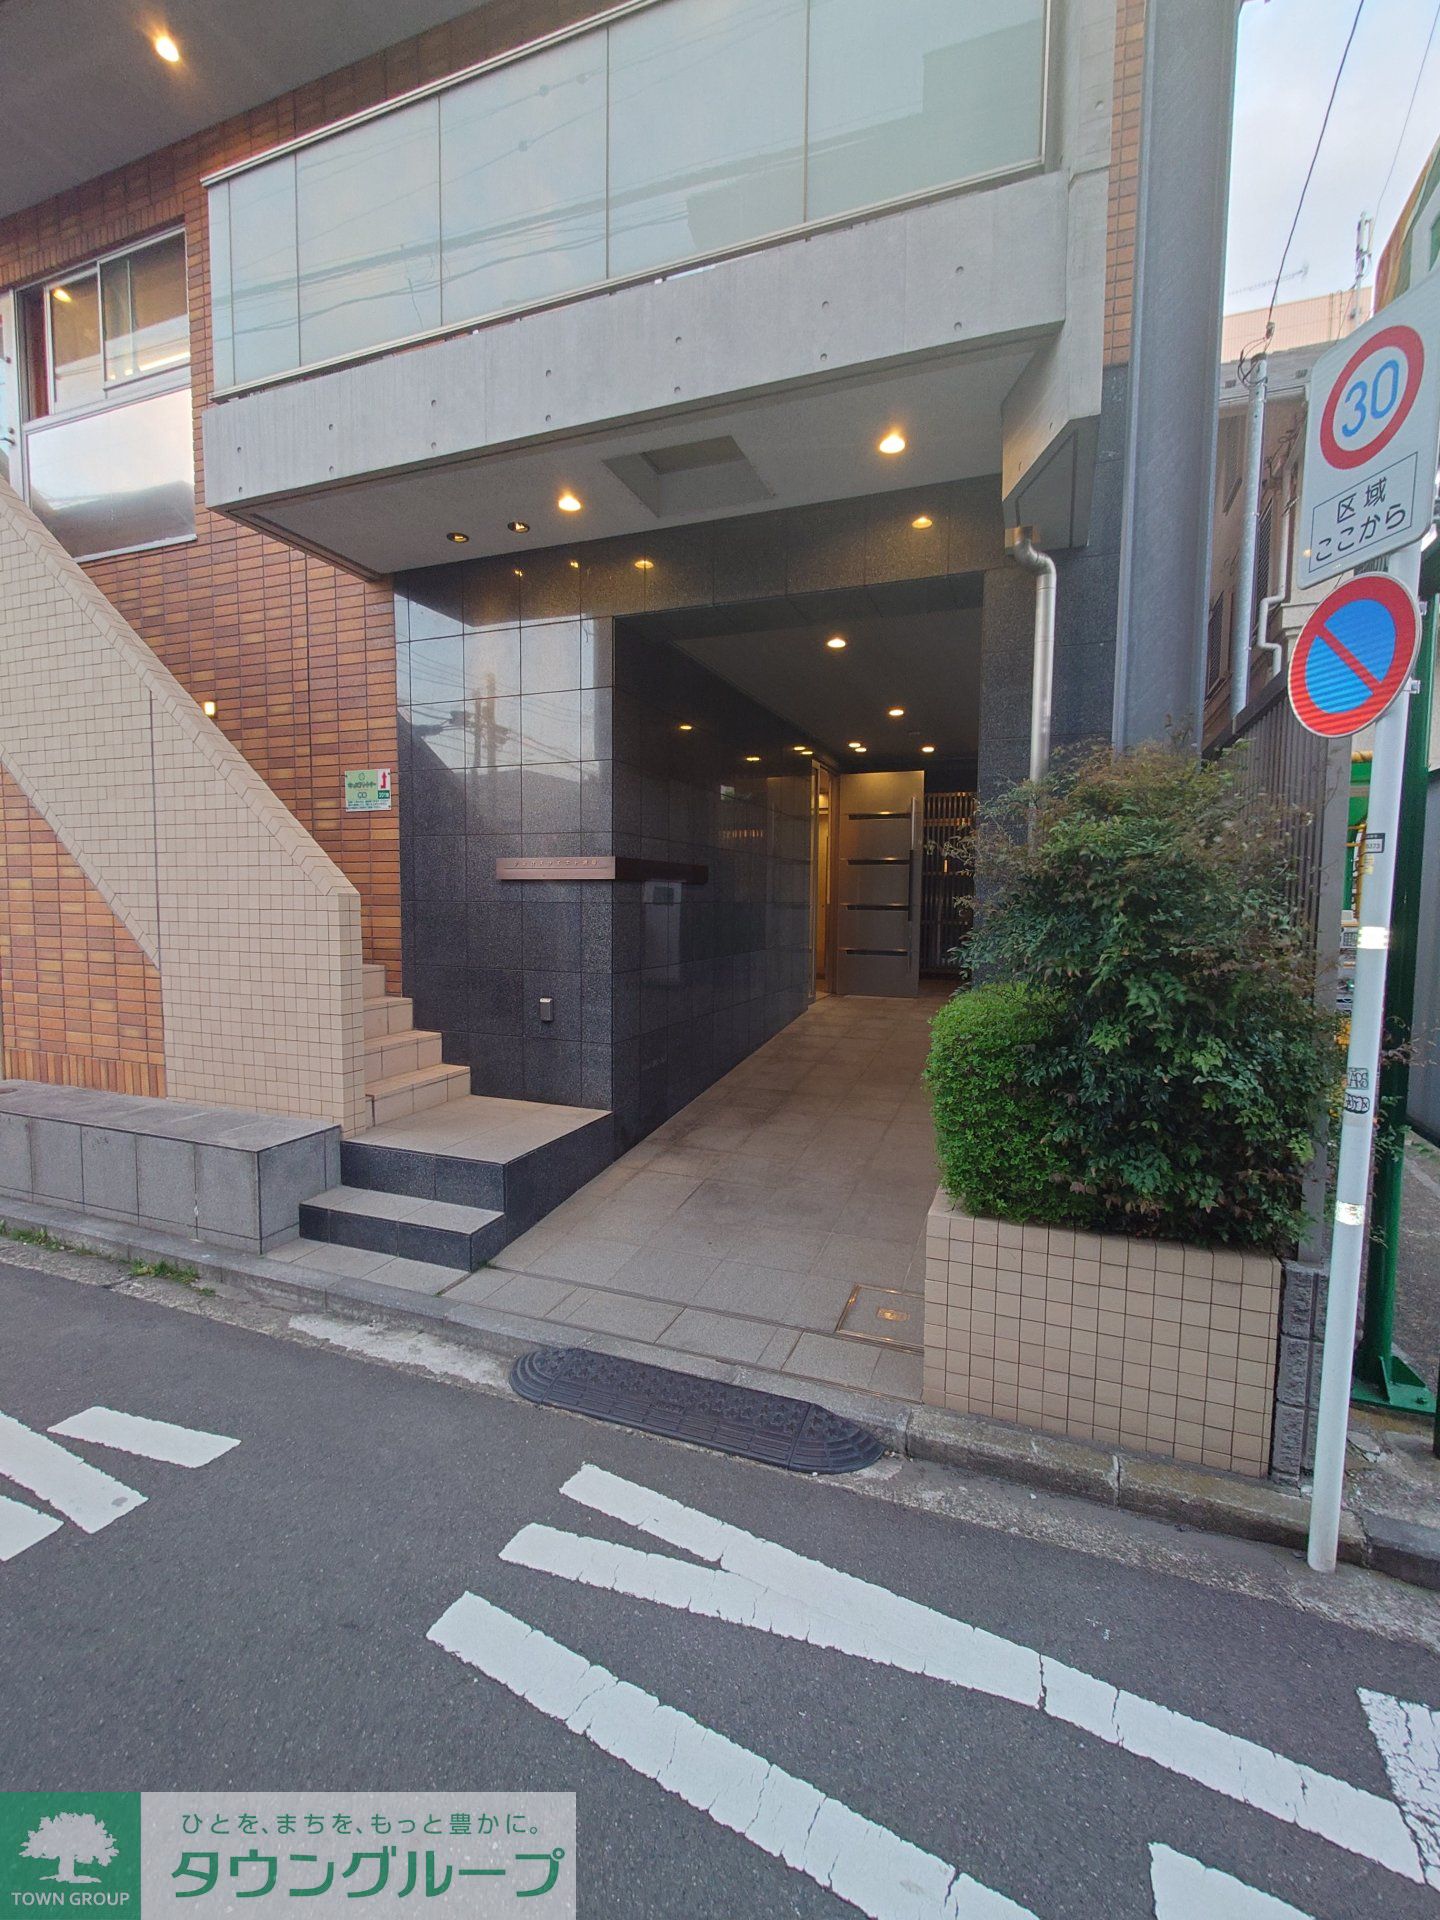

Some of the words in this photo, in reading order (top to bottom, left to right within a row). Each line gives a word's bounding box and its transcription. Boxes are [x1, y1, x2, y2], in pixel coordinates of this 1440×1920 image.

[1341, 359, 1400, 438] 30
[1337, 476, 1387, 523] 区域
[1315, 503, 1405, 562] ここから
